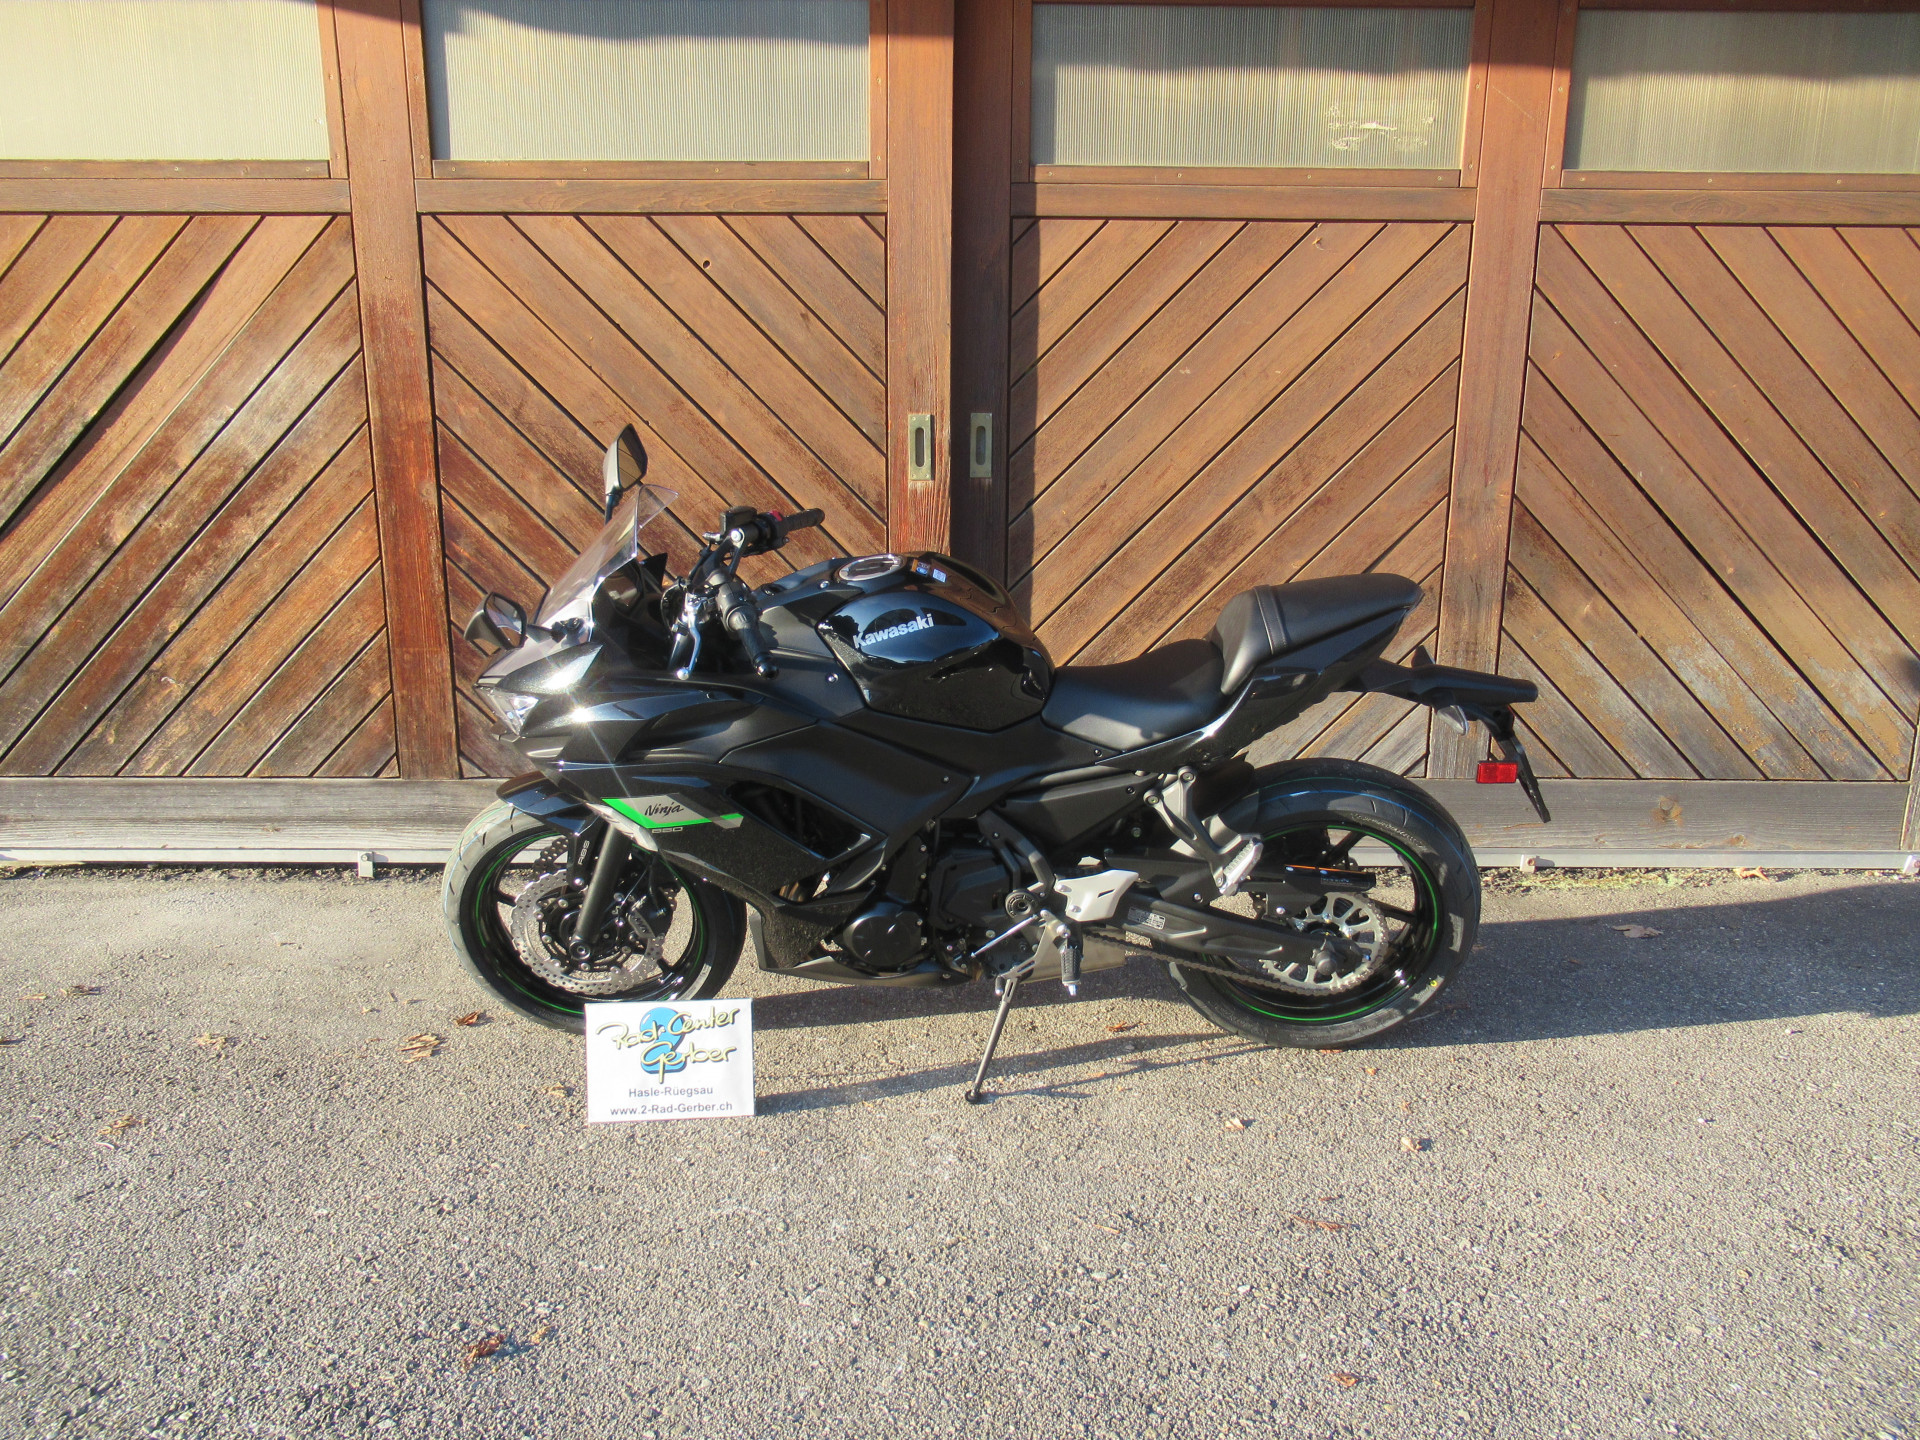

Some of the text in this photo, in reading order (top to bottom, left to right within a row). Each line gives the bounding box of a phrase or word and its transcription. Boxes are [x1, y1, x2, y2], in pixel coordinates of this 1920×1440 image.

[852, 613, 935, 649] Kawasaki
[644, 801, 685, 817] Ninja
[641, 1041, 737, 1084] Gerber
[628, 1086, 714, 1098] Hasle-Rüegsau
[610, 1101, 733, 1116] www.2-Rad-Gerber.ch
